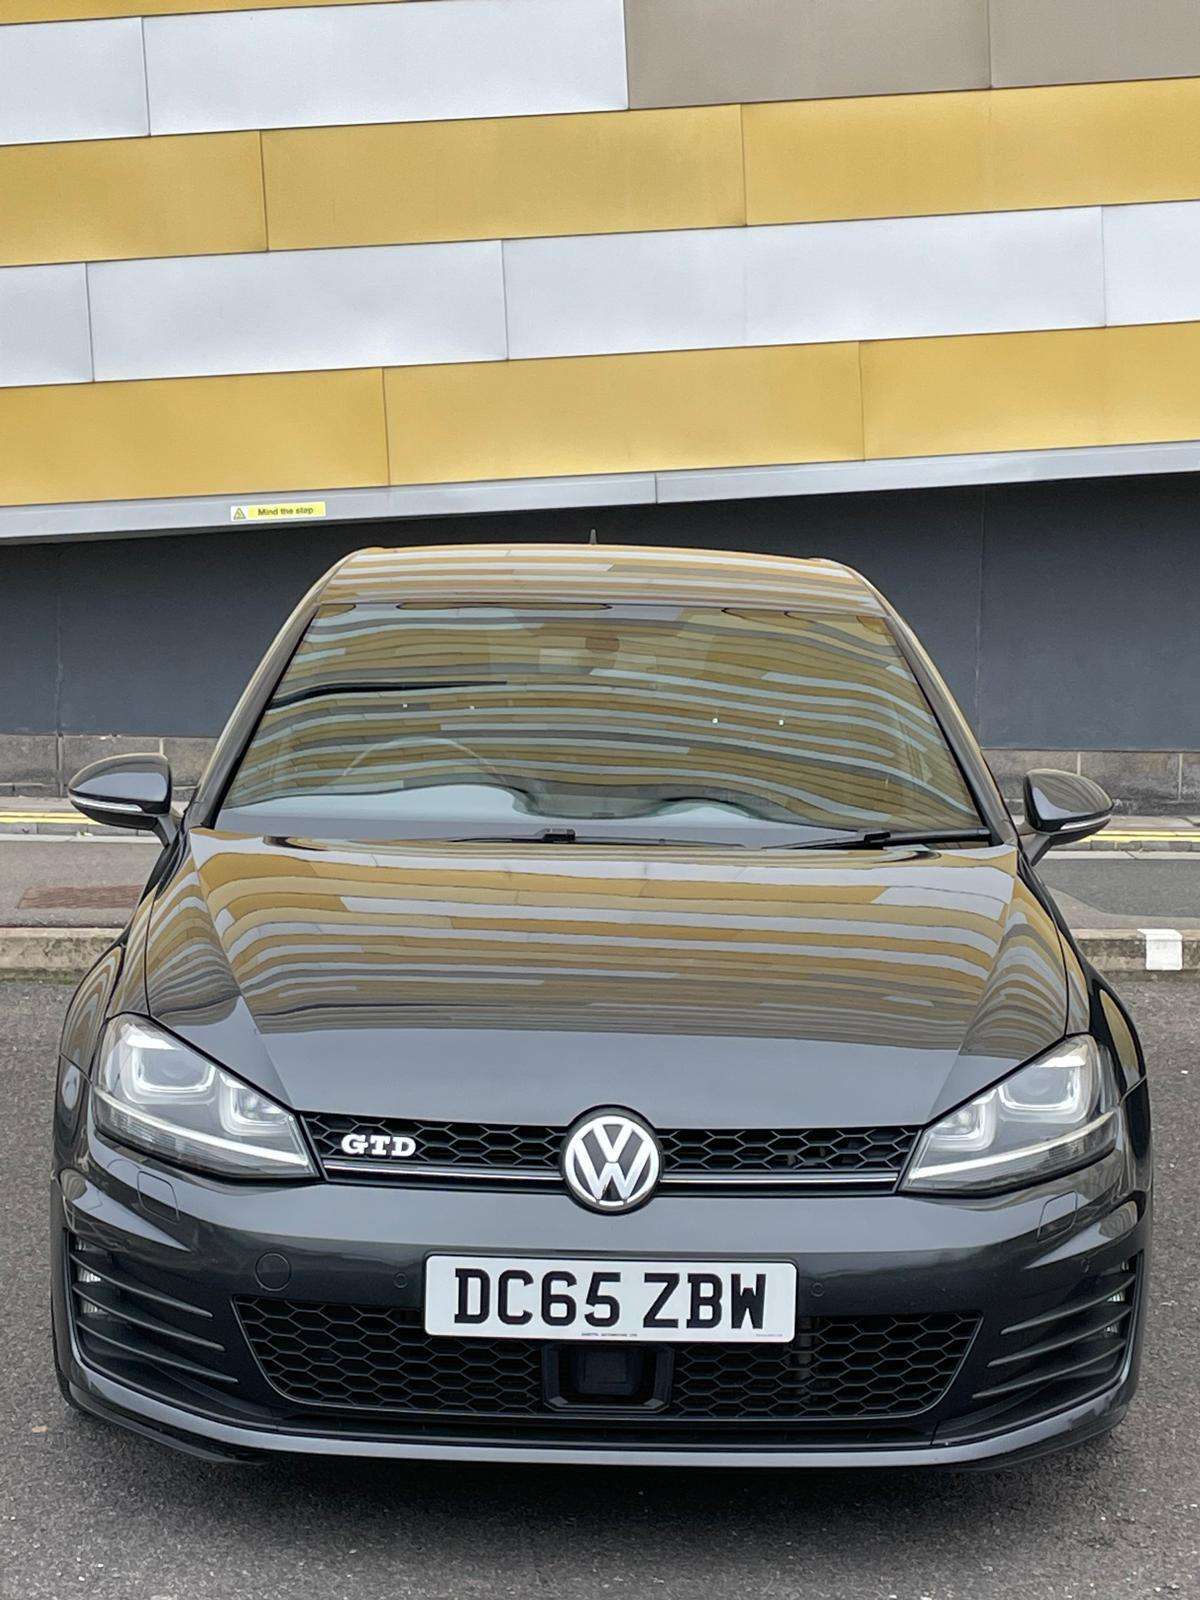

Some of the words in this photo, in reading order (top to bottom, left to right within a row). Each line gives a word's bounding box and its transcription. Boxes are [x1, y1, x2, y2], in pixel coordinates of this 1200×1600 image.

[257, 508, 279, 516] Mind
[296, 507, 314, 515] step
[341, 1134, 417, 1157] GTD
[454, 1267, 621, 1327] DC65
[642, 1272, 767, 1330] ZBW
